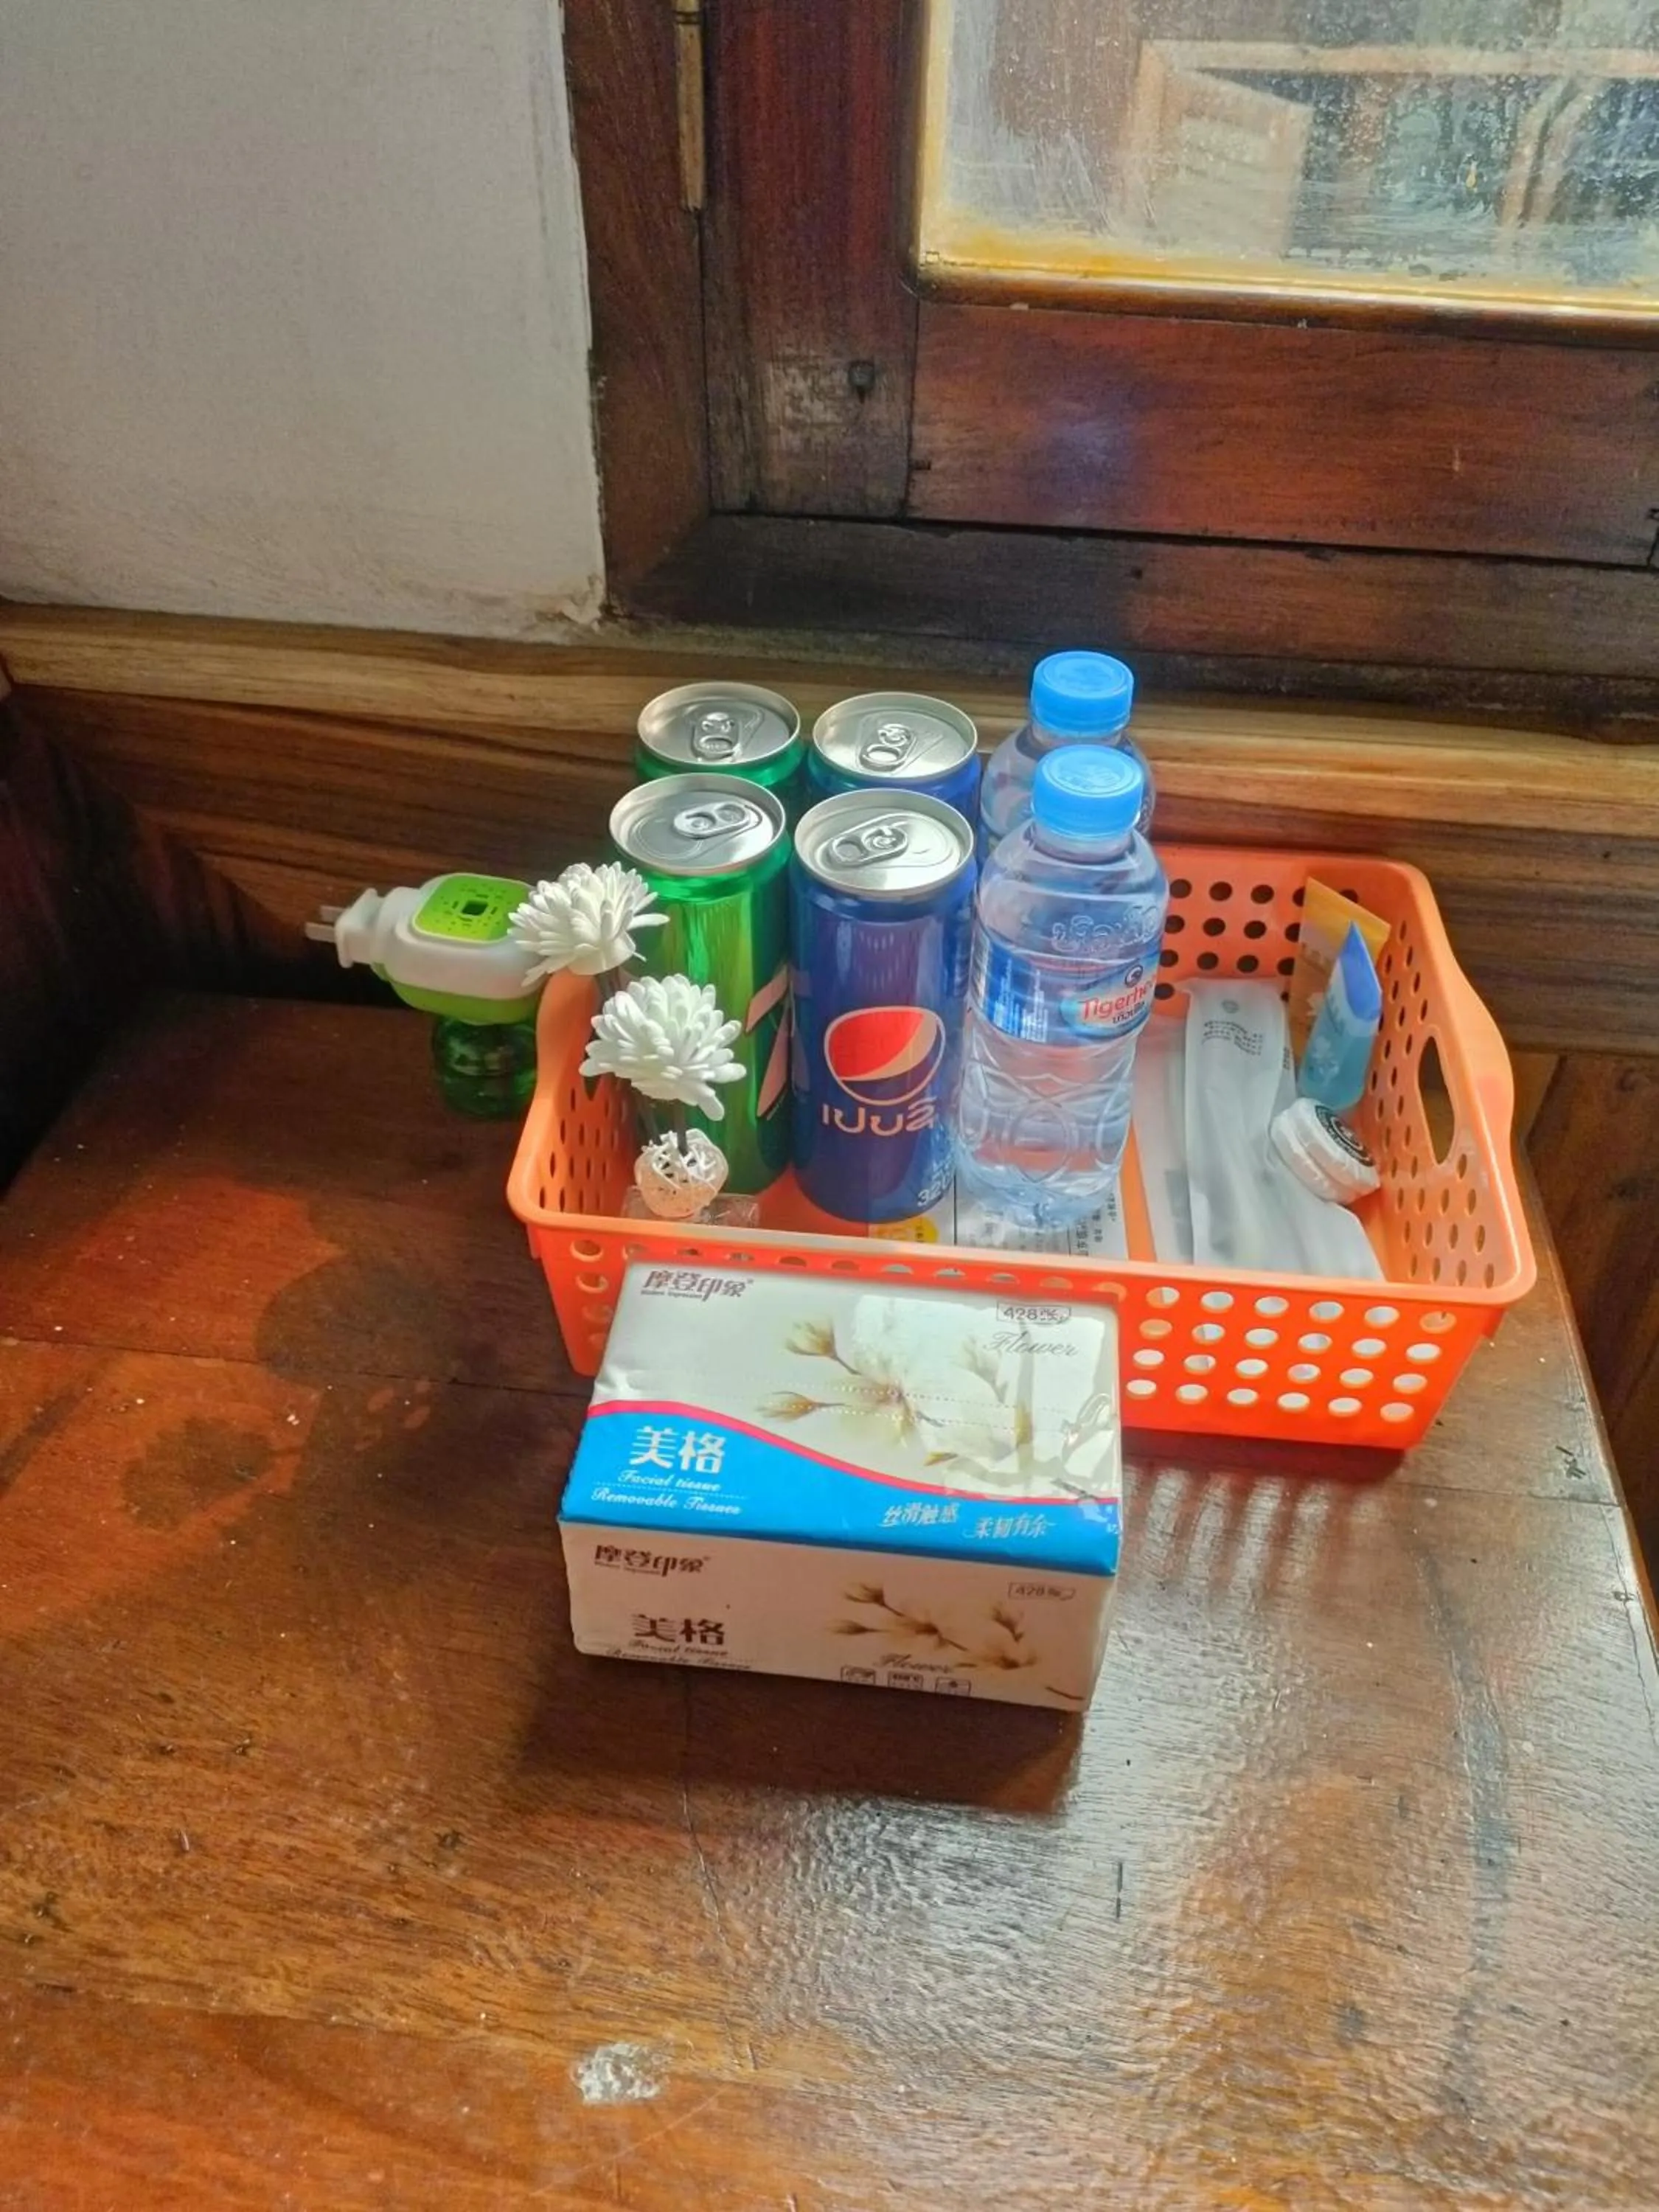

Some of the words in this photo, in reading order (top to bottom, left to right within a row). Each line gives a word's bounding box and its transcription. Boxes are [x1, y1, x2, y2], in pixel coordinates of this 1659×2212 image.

[643, 1270, 747, 1301] 摩登印象
[983, 1330, 1079, 1357] Flower
[628, 1425, 727, 1474] 美格
[617, 1469, 675, 1487] Facial
[675, 1477, 722, 1492] tissue
[591, 1486, 678, 1509] Removable
[631, 1613, 726, 1646] 美格
